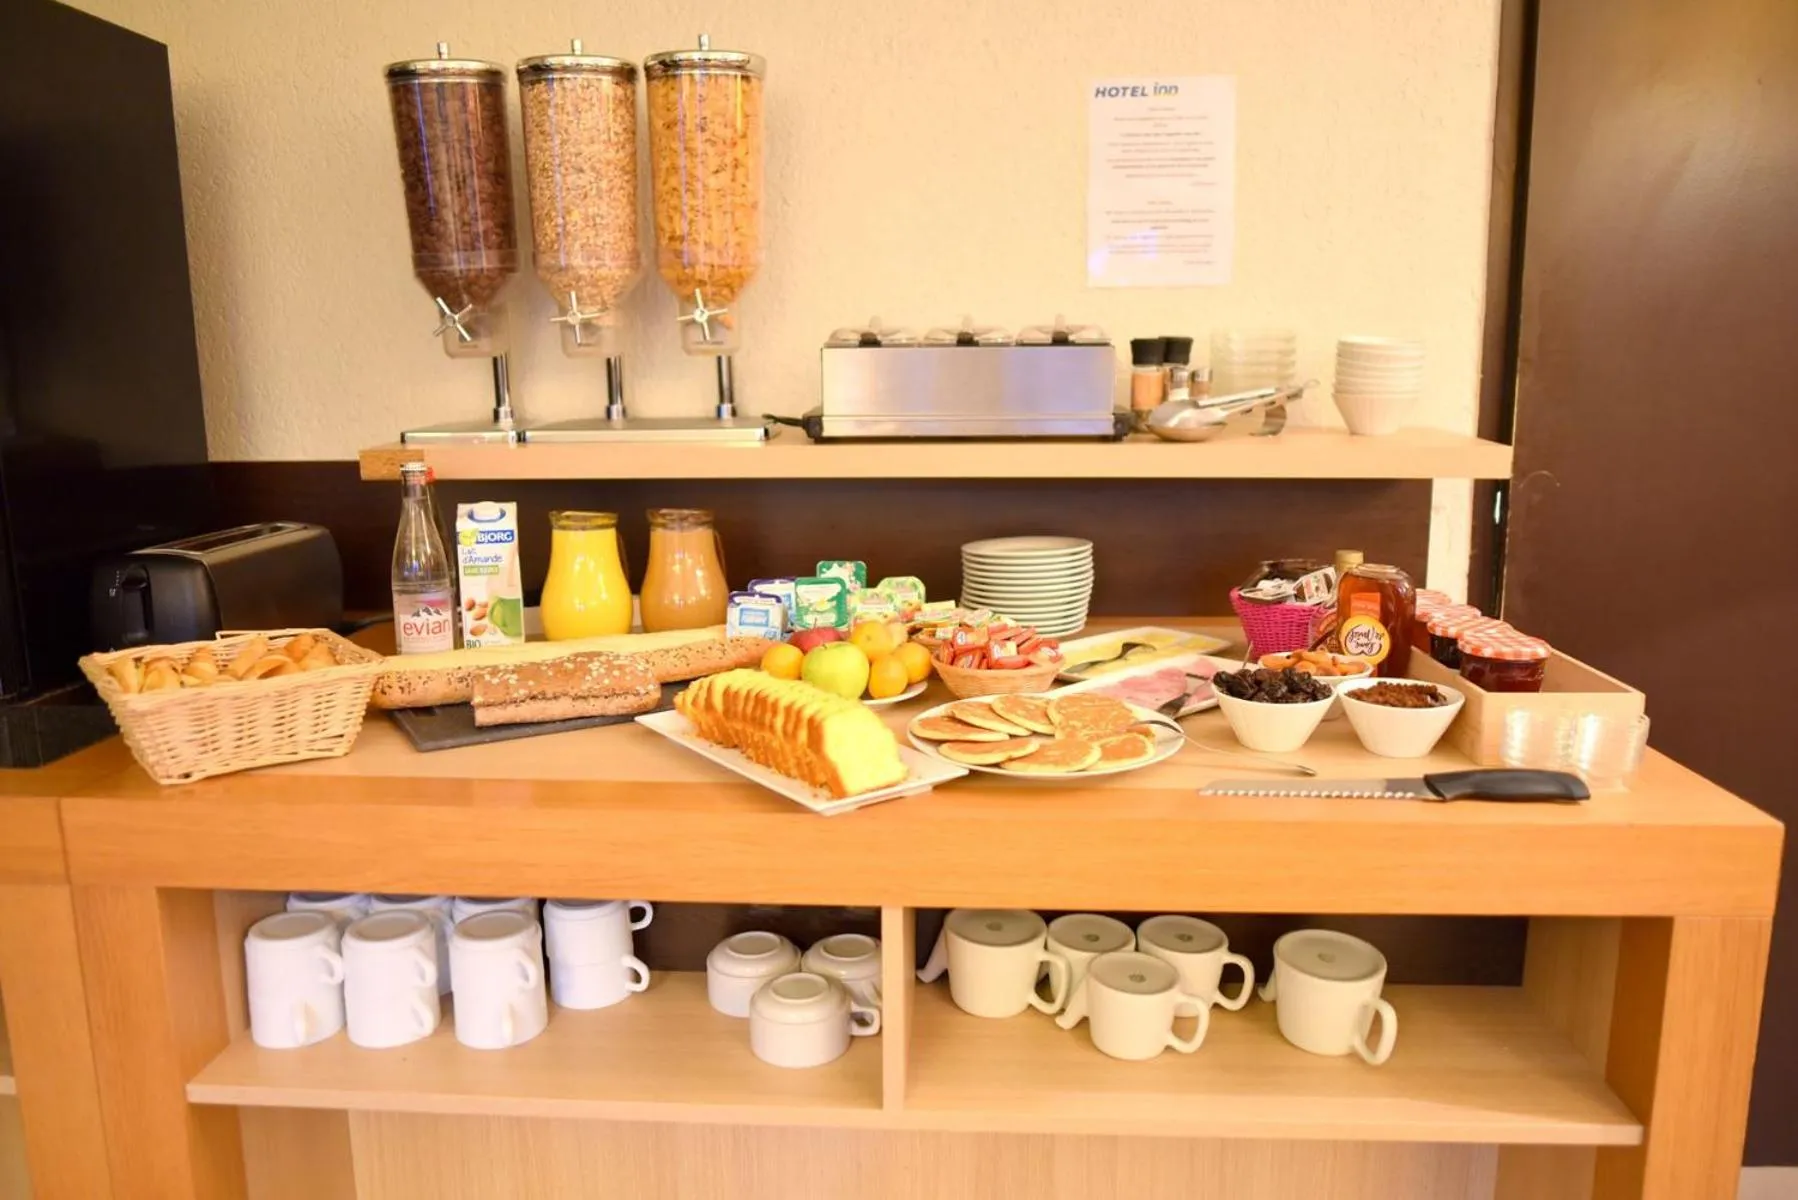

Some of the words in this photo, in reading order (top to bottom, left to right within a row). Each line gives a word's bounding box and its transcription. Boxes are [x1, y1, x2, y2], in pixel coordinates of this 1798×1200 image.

[1094, 85, 1149, 98] HOTEL
[1153, 81, 1179, 96] inn
[477, 531, 513, 543] BJORG
[403, 618, 450, 636] evian
